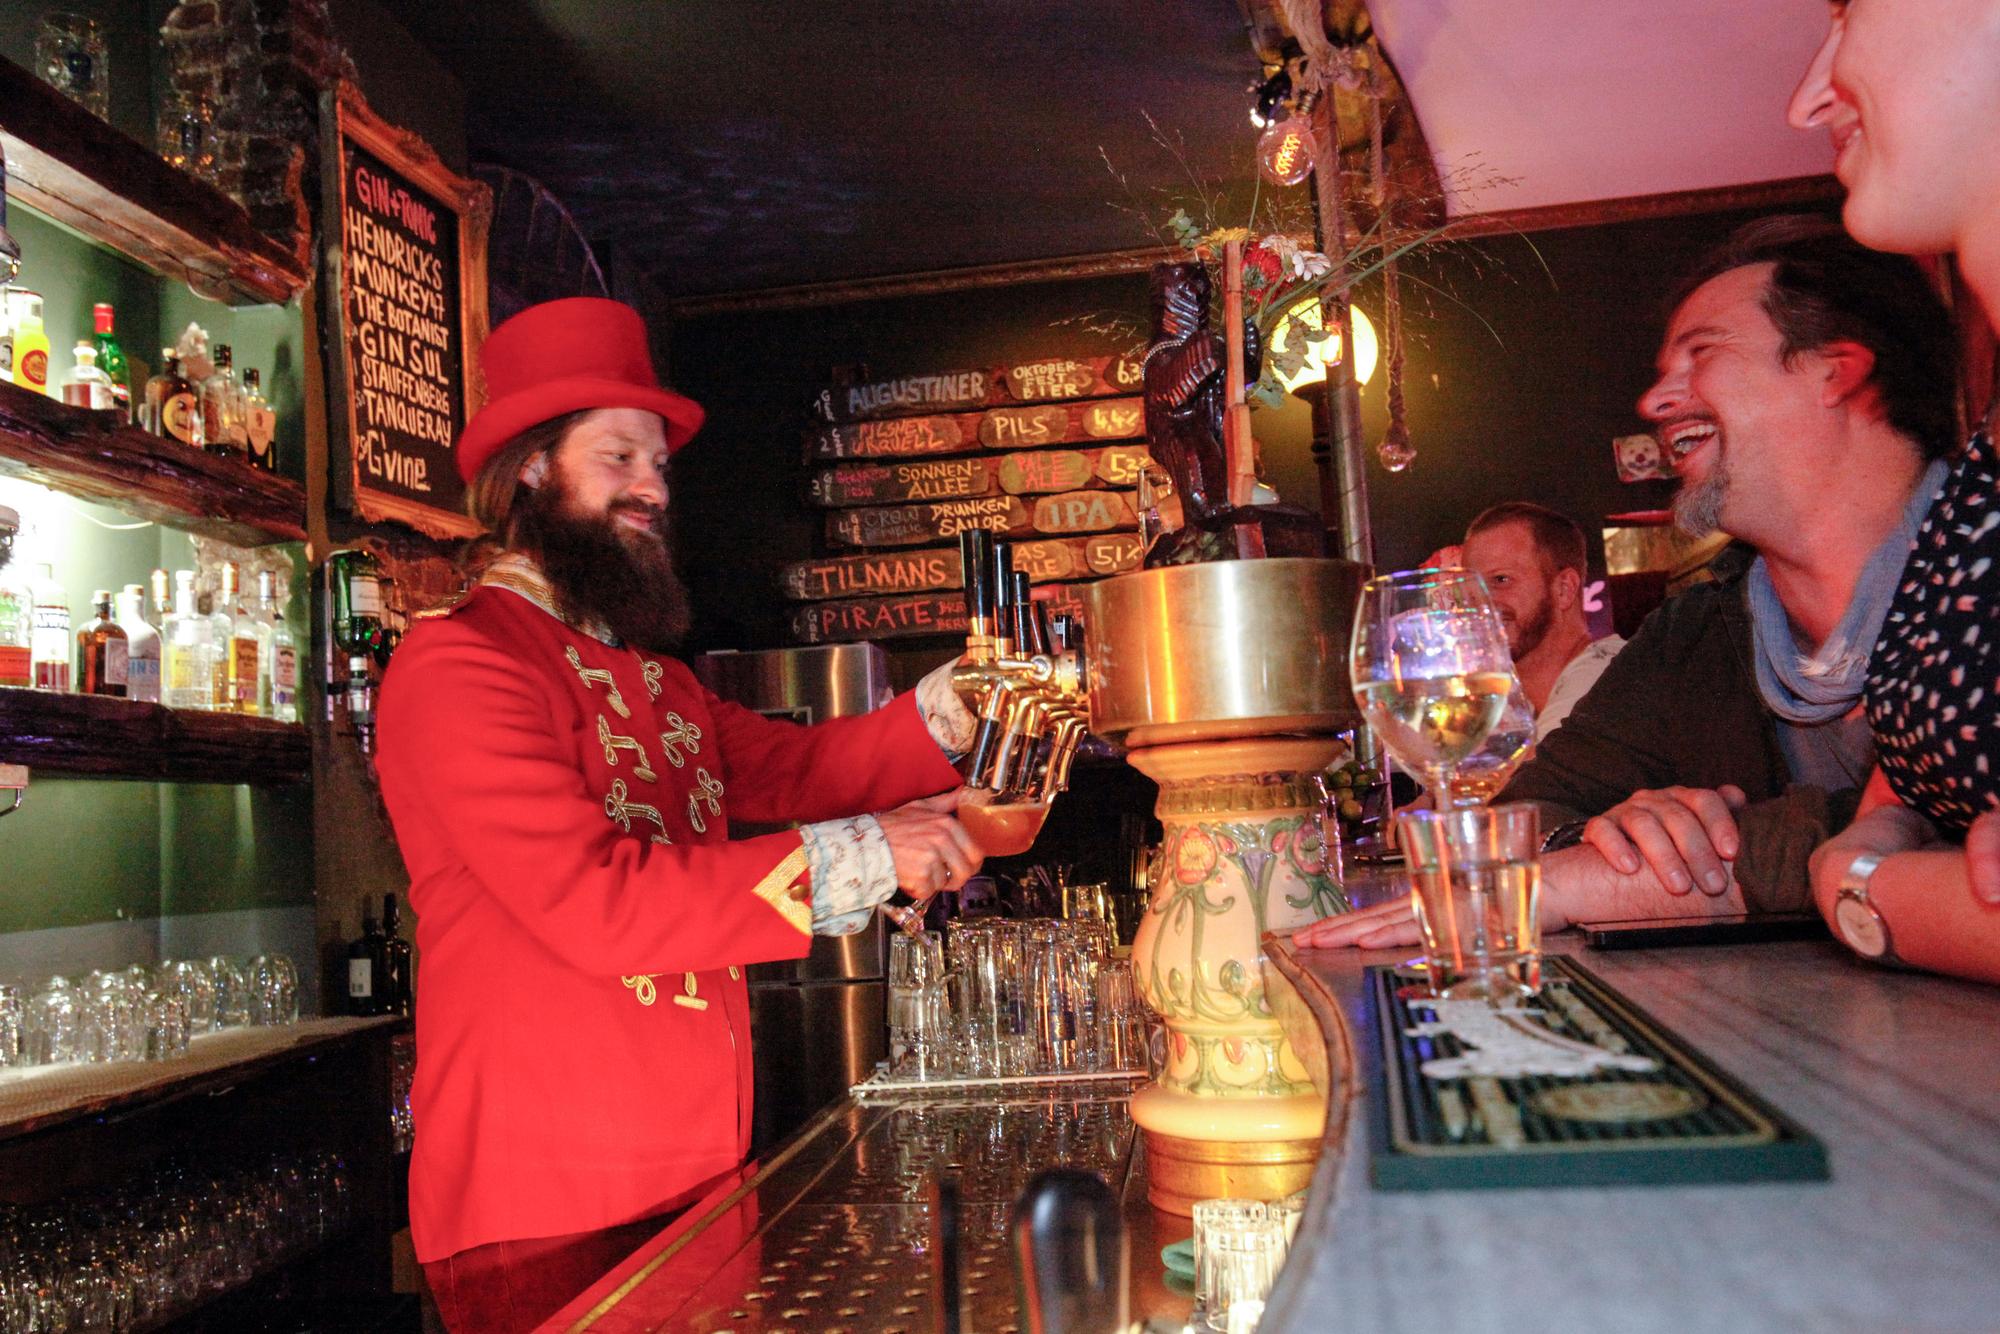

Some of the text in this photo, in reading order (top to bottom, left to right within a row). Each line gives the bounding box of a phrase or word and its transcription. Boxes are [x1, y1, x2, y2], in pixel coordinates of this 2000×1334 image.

[349, 206, 442, 290] HENDRICK'S
[353, 284, 449, 350] THE BOTANIST
[360, 321, 449, 385] GIN SUL
[1025, 373, 1067, 386] FEST
[1117, 360, 1141, 384] 6,3
[361, 354, 449, 416] STAUFFENBERG
[850, 372, 984, 413] AUGUSTINER
[1023, 383, 1079, 399] BIER
[362, 389, 451, 448] TANQUERAY
[994, 416, 1048, 440] PILS
[898, 461, 981, 483] SONNEN-
[1015, 452, 1070, 472] PALE
[908, 477, 971, 498] ALLEE
[1026, 472, 1073, 490] ALE
[930, 496, 1010, 521] DRUNKEN
[1051, 498, 1110, 527] IPA
[1016, 545, 1046, 559] AS
[1094, 545, 1142, 568] 5,1%
[812, 558, 946, 594] TILMANS
[823, 601, 932, 634] PIRATE
